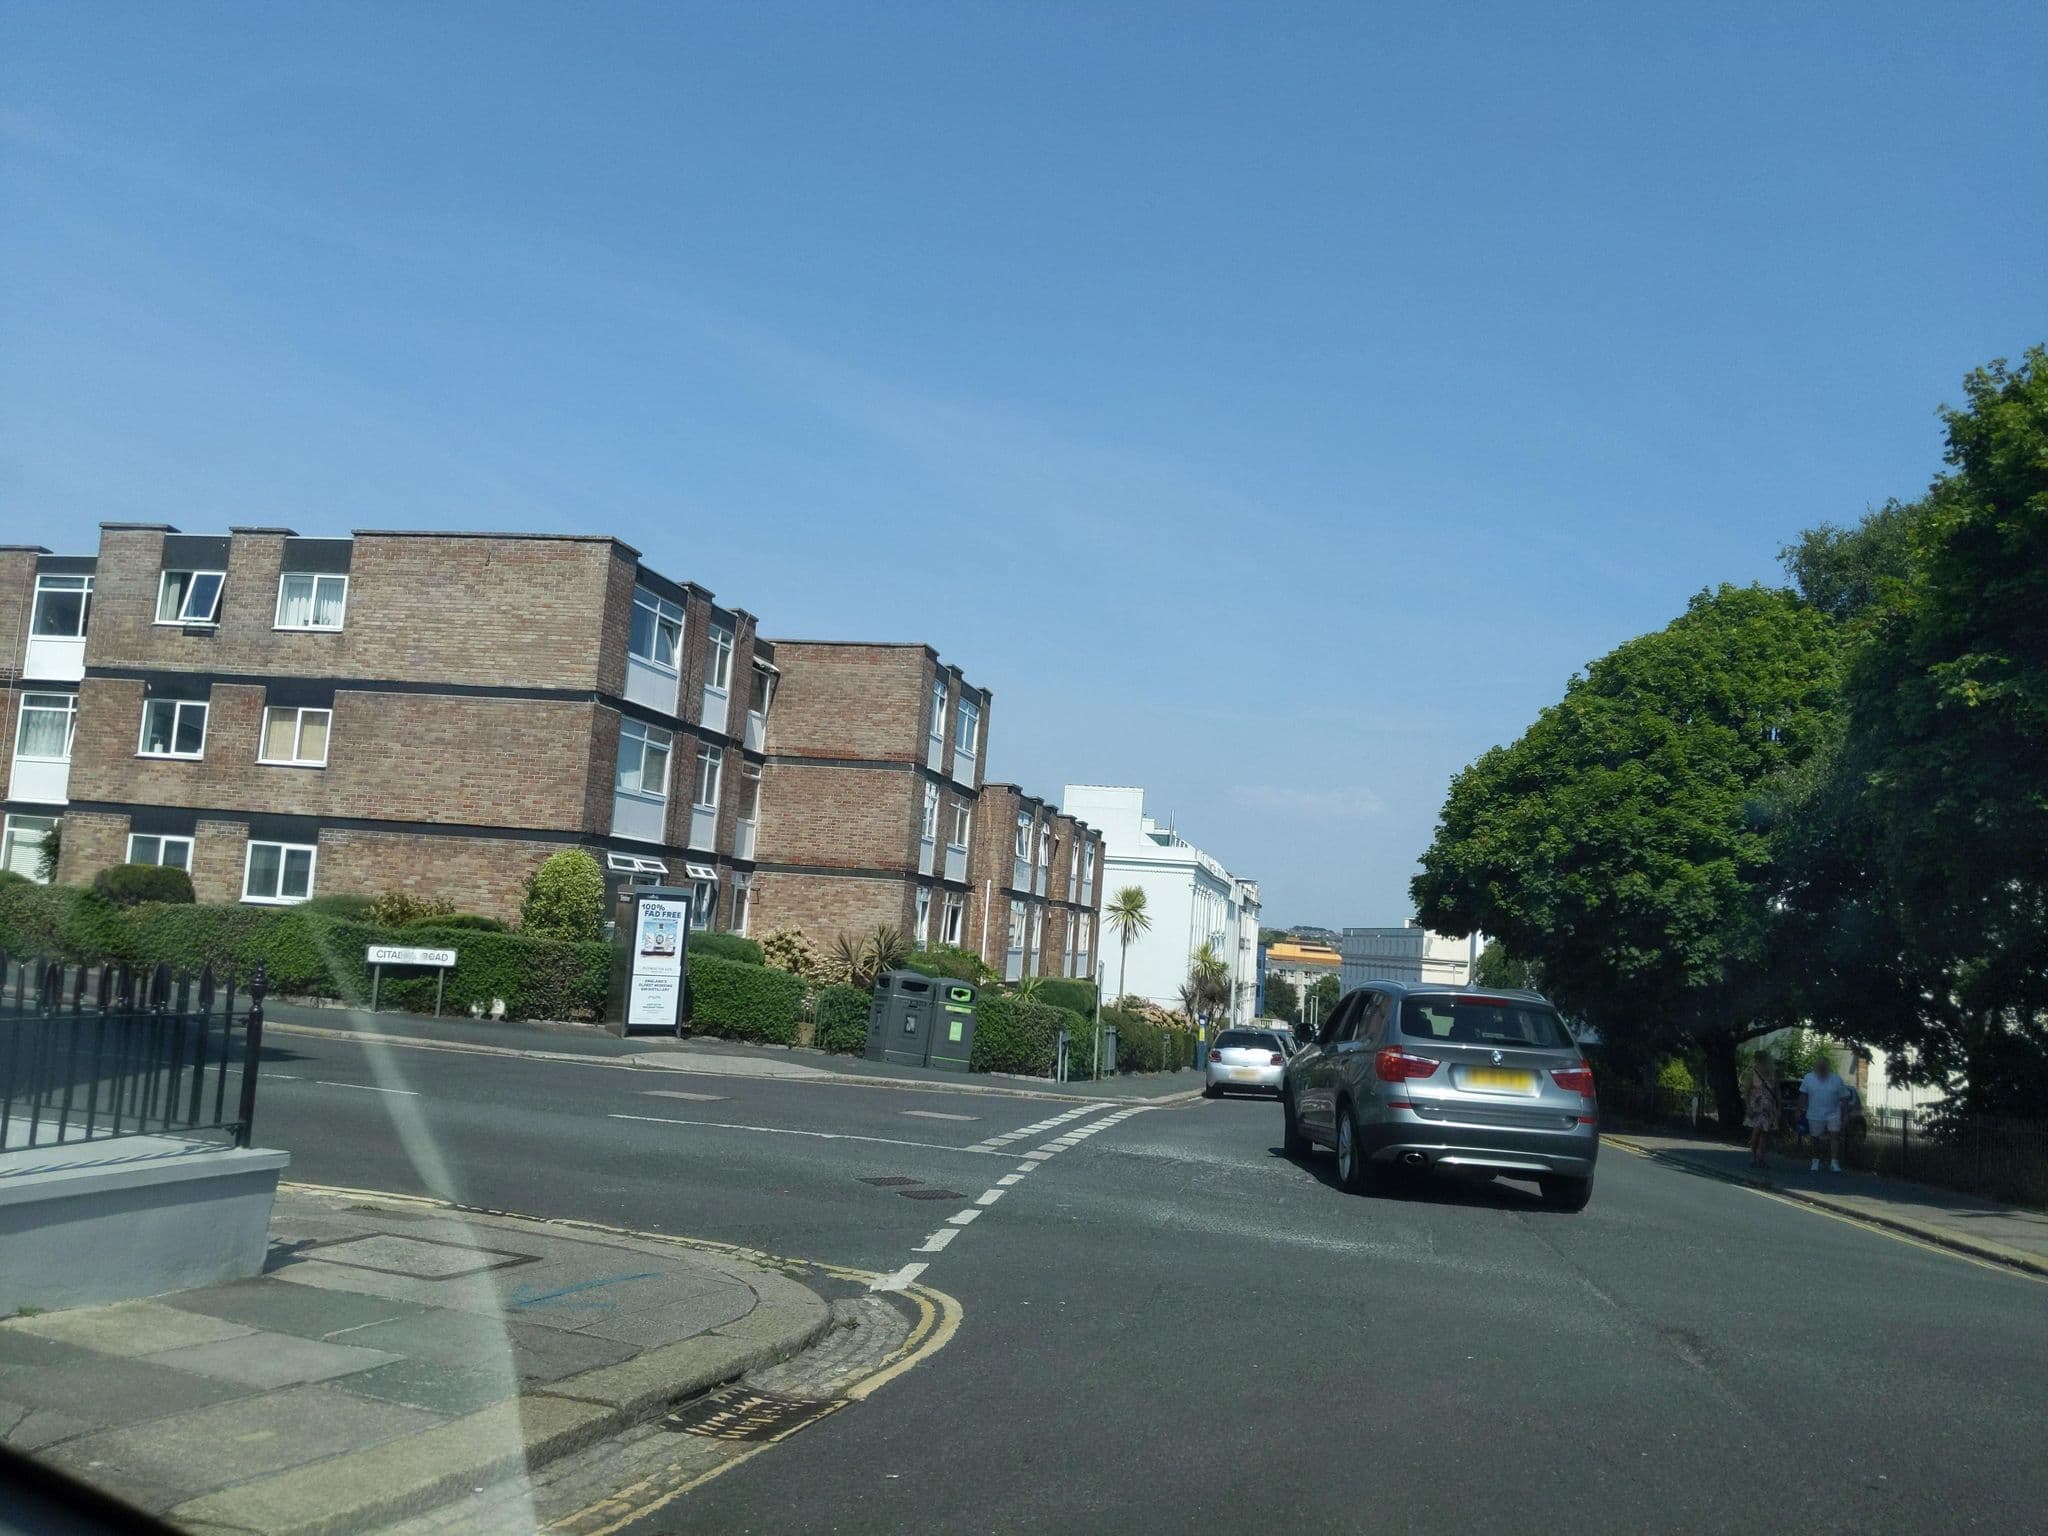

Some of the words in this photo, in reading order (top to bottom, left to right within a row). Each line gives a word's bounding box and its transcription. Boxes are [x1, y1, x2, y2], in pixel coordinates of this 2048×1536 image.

[641, 903, 666, 911] 100%
[644, 910, 661, 918] FAD
[662, 911, 682, 919] FREE
[376, 949, 416, 960] CITA
